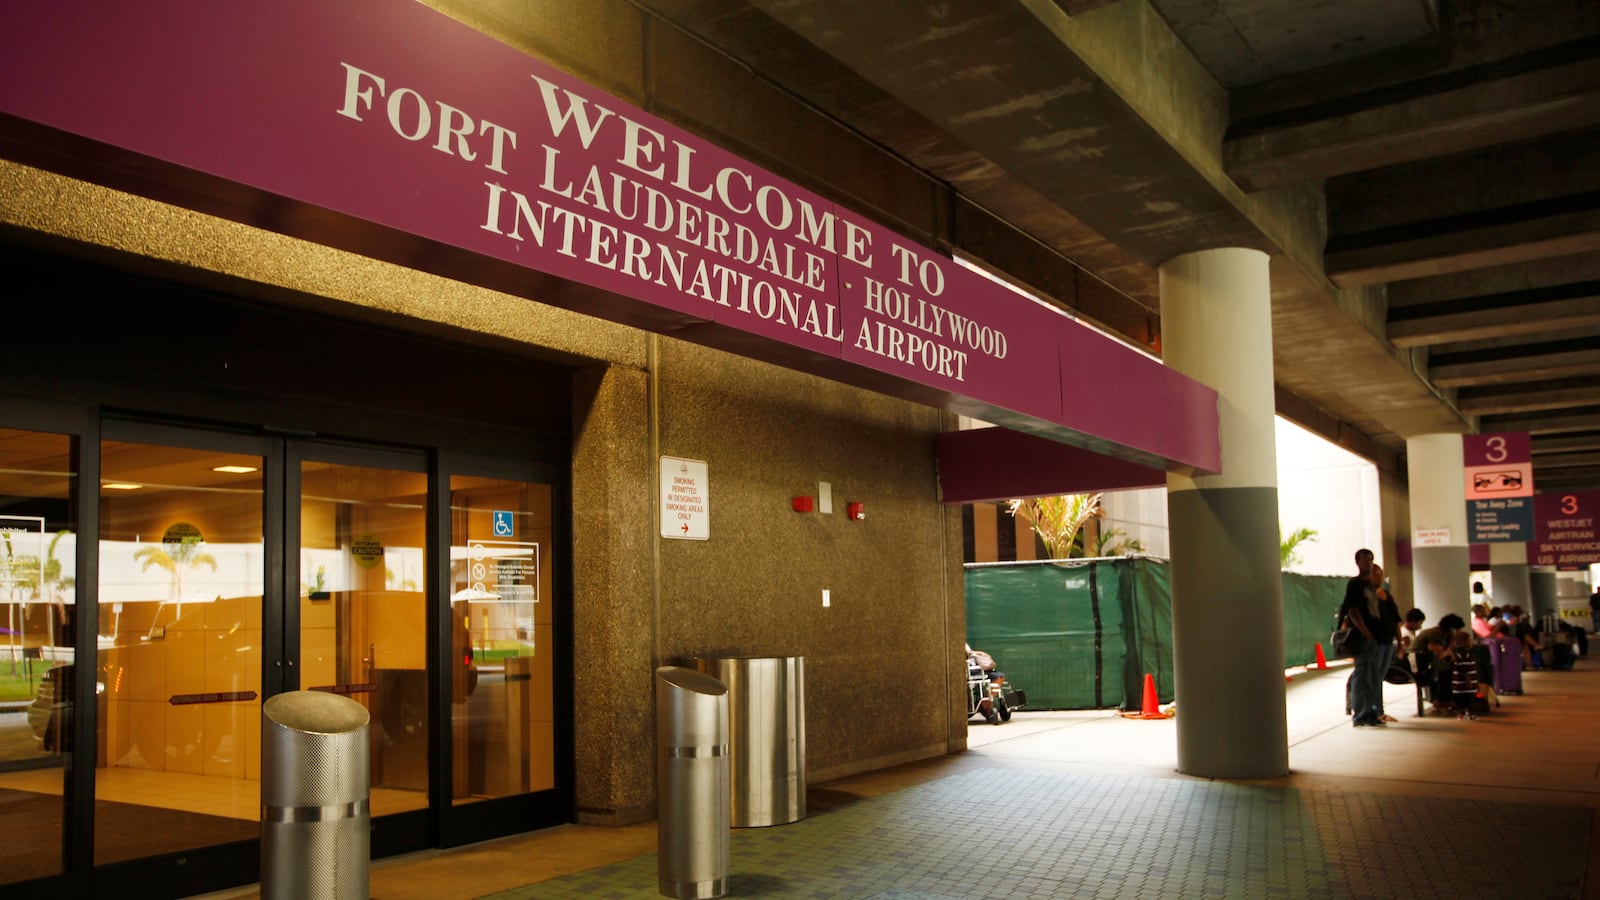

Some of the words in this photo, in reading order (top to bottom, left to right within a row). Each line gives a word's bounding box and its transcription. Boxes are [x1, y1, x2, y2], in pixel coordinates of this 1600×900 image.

[531, 74, 873, 269] WELCOME
[892, 243, 945, 297] TO
[337, 62, 517, 175] FORT
[539, 144, 826, 292] LAUDERDALE
[864, 277, 1008, 360] HOLLYWOOD
[480, 182, 845, 343] INTERNATIONAL
[854, 317, 968, 382] AIRPORT
[1485, 436, 1508, 463] 3
[674, 476, 694, 486] SMOKING
[671, 485, 697, 495] PERMITTED
[674, 494, 702, 504] DESIGNATED
[666, 503, 687, 511] SMOKING
[688, 504, 704, 513] AREAS
[1561, 495, 1578, 515] 3
[677, 512, 692, 520] ONLY
[1547, 519, 1592, 529] WESTJET
[1549, 531, 1594, 540] AIRTRAN
[353, 546, 383, 554] CAUTION
[1537, 555, 1553, 564] US
[1559, 553, 1600, 563] AIRWAY
[1563, 609, 1588, 617] TAXI
